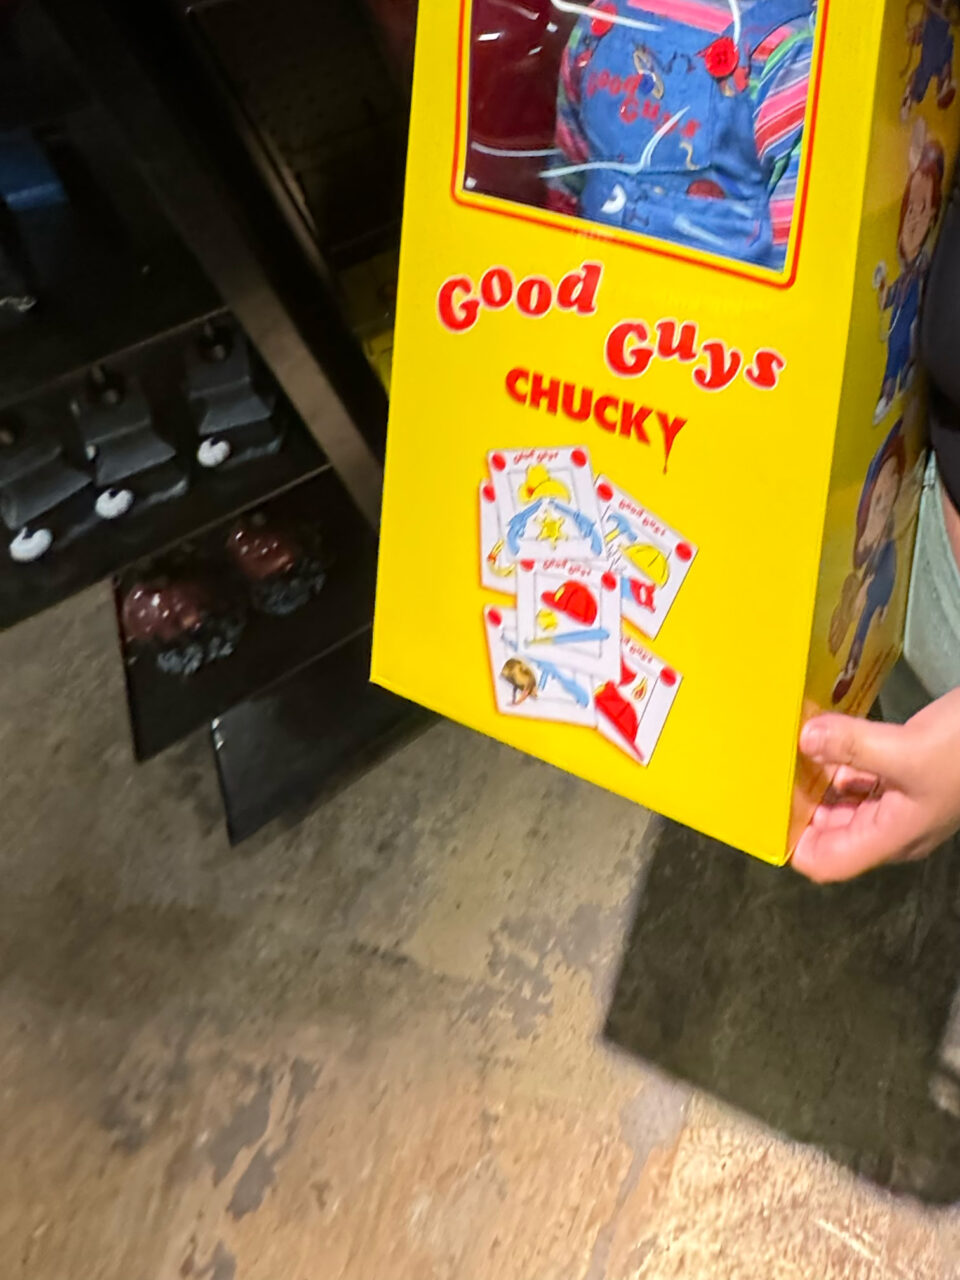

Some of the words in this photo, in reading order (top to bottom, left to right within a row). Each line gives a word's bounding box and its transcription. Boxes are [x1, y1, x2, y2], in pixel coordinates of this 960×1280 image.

[436, 261, 605, 334] Good
[604, 317, 786, 392] Guys
[505, 367, 688, 474] CHUCKY
